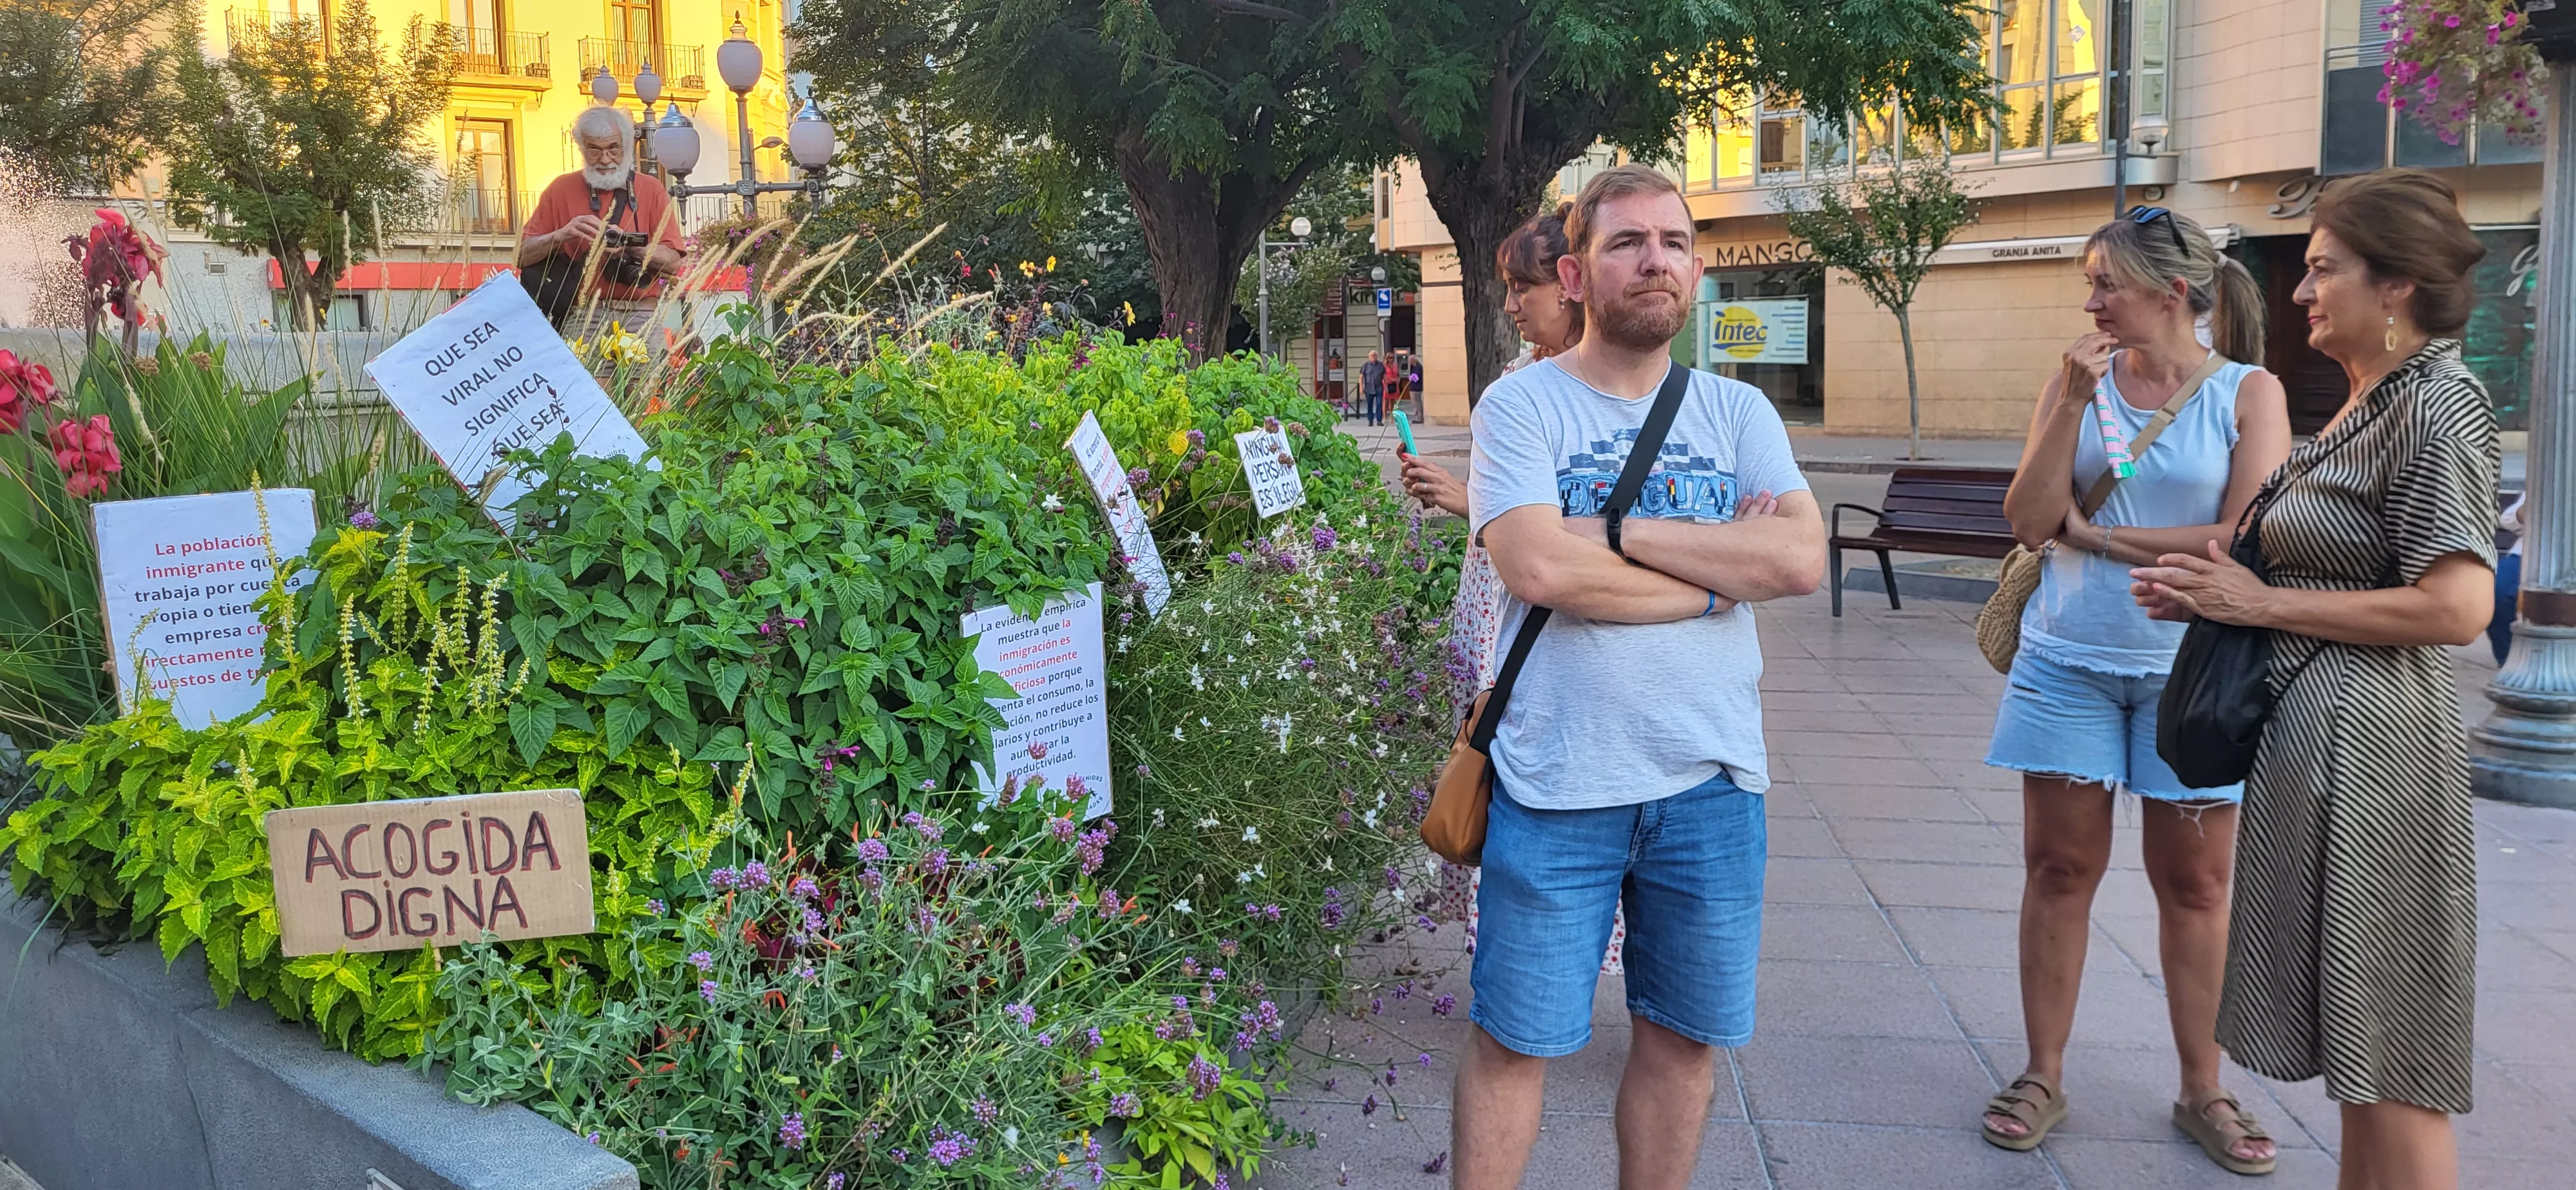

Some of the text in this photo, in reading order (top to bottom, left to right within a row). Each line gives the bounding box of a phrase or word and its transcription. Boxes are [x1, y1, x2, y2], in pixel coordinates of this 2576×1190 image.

[1993, 245, 2061, 258] GRANJA ANITA
[425, 321, 500, 377] QUE SEA
[441, 345, 524, 407] VIRAL NO
[464, 372, 549, 437] SIGNIFICA
[494, 403, 566, 458] QUE SEA
[1258, 487, 1273, 509] ES
[155, 533, 269, 557] La población
[146, 556, 283, 579] inmigrante que
[135, 576, 301, 602] trabaja por cuea
[140, 603, 263, 625] ropia o tien
[165, 625, 242, 645] empresa
[981, 622, 992, 632] La
[998, 618, 1071, 646] muestra que la
[144, 647, 254, 668] irectamente
[999, 635, 1070, 662] inmigración es
[221, 669, 242, 682] de
[999, 650, 1077, 678] conómicamente
[1048, 665, 1083, 685] porque
[1027, 694, 1035, 705] el
[1037, 683, 1083, 703] consumo,
[1086, 678, 1094, 688] la
[1036, 709, 1048, 719] no
[1051, 698, 1083, 716] reduce
[1085, 693, 1099, 705] los
[1025, 731, 1031, 742] y
[1033, 714, 1084, 737] contribuye
[1087, 712, 1093, 721] a
[1063, 735, 1070, 746] la
